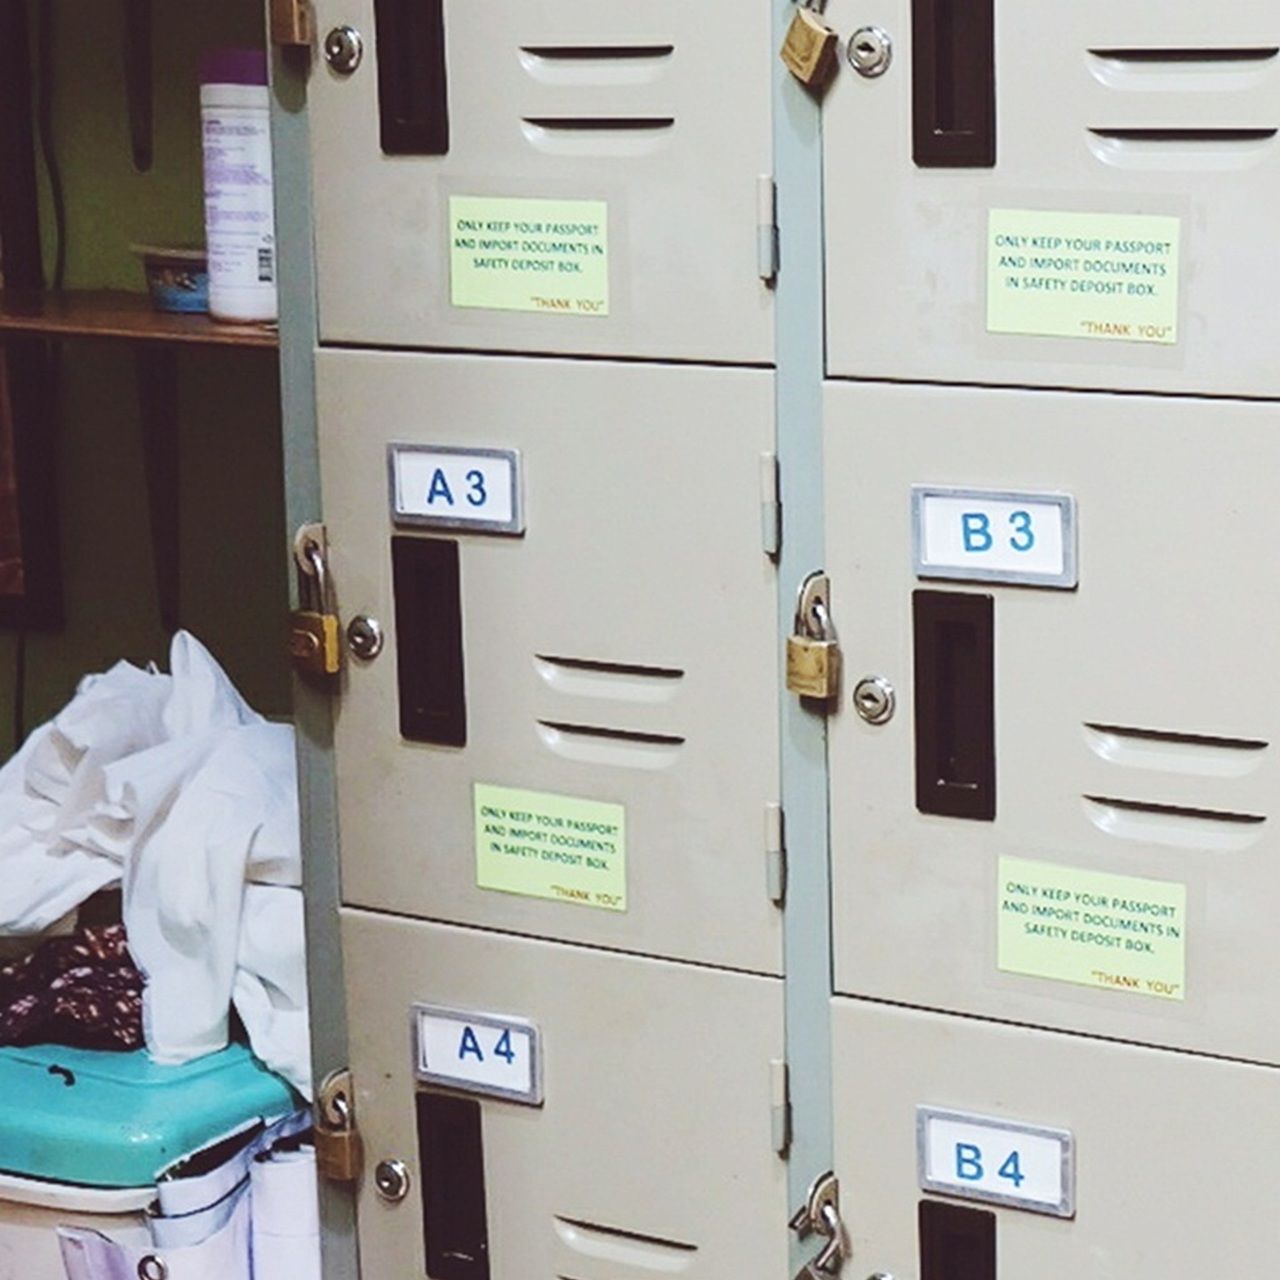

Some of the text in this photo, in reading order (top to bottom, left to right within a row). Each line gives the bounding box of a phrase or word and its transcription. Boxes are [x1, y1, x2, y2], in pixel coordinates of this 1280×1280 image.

[995, 234, 1170, 254] ONLY KEEP YOUR PASSPORT
[998, 255, 1166, 275] AND IMPORT DOCUMENTS
[1005, 276, 1155, 295] IN SAFETY DEPOSIT BOX.
[1006, 881, 1175, 918] ONLY KEEP YOUR PASSPORT
[1002, 899, 1179, 938] AND IMPORT DOCUMENTS IN
[1024, 921, 1154, 953] SAFETY DEPOSIT BOX.
